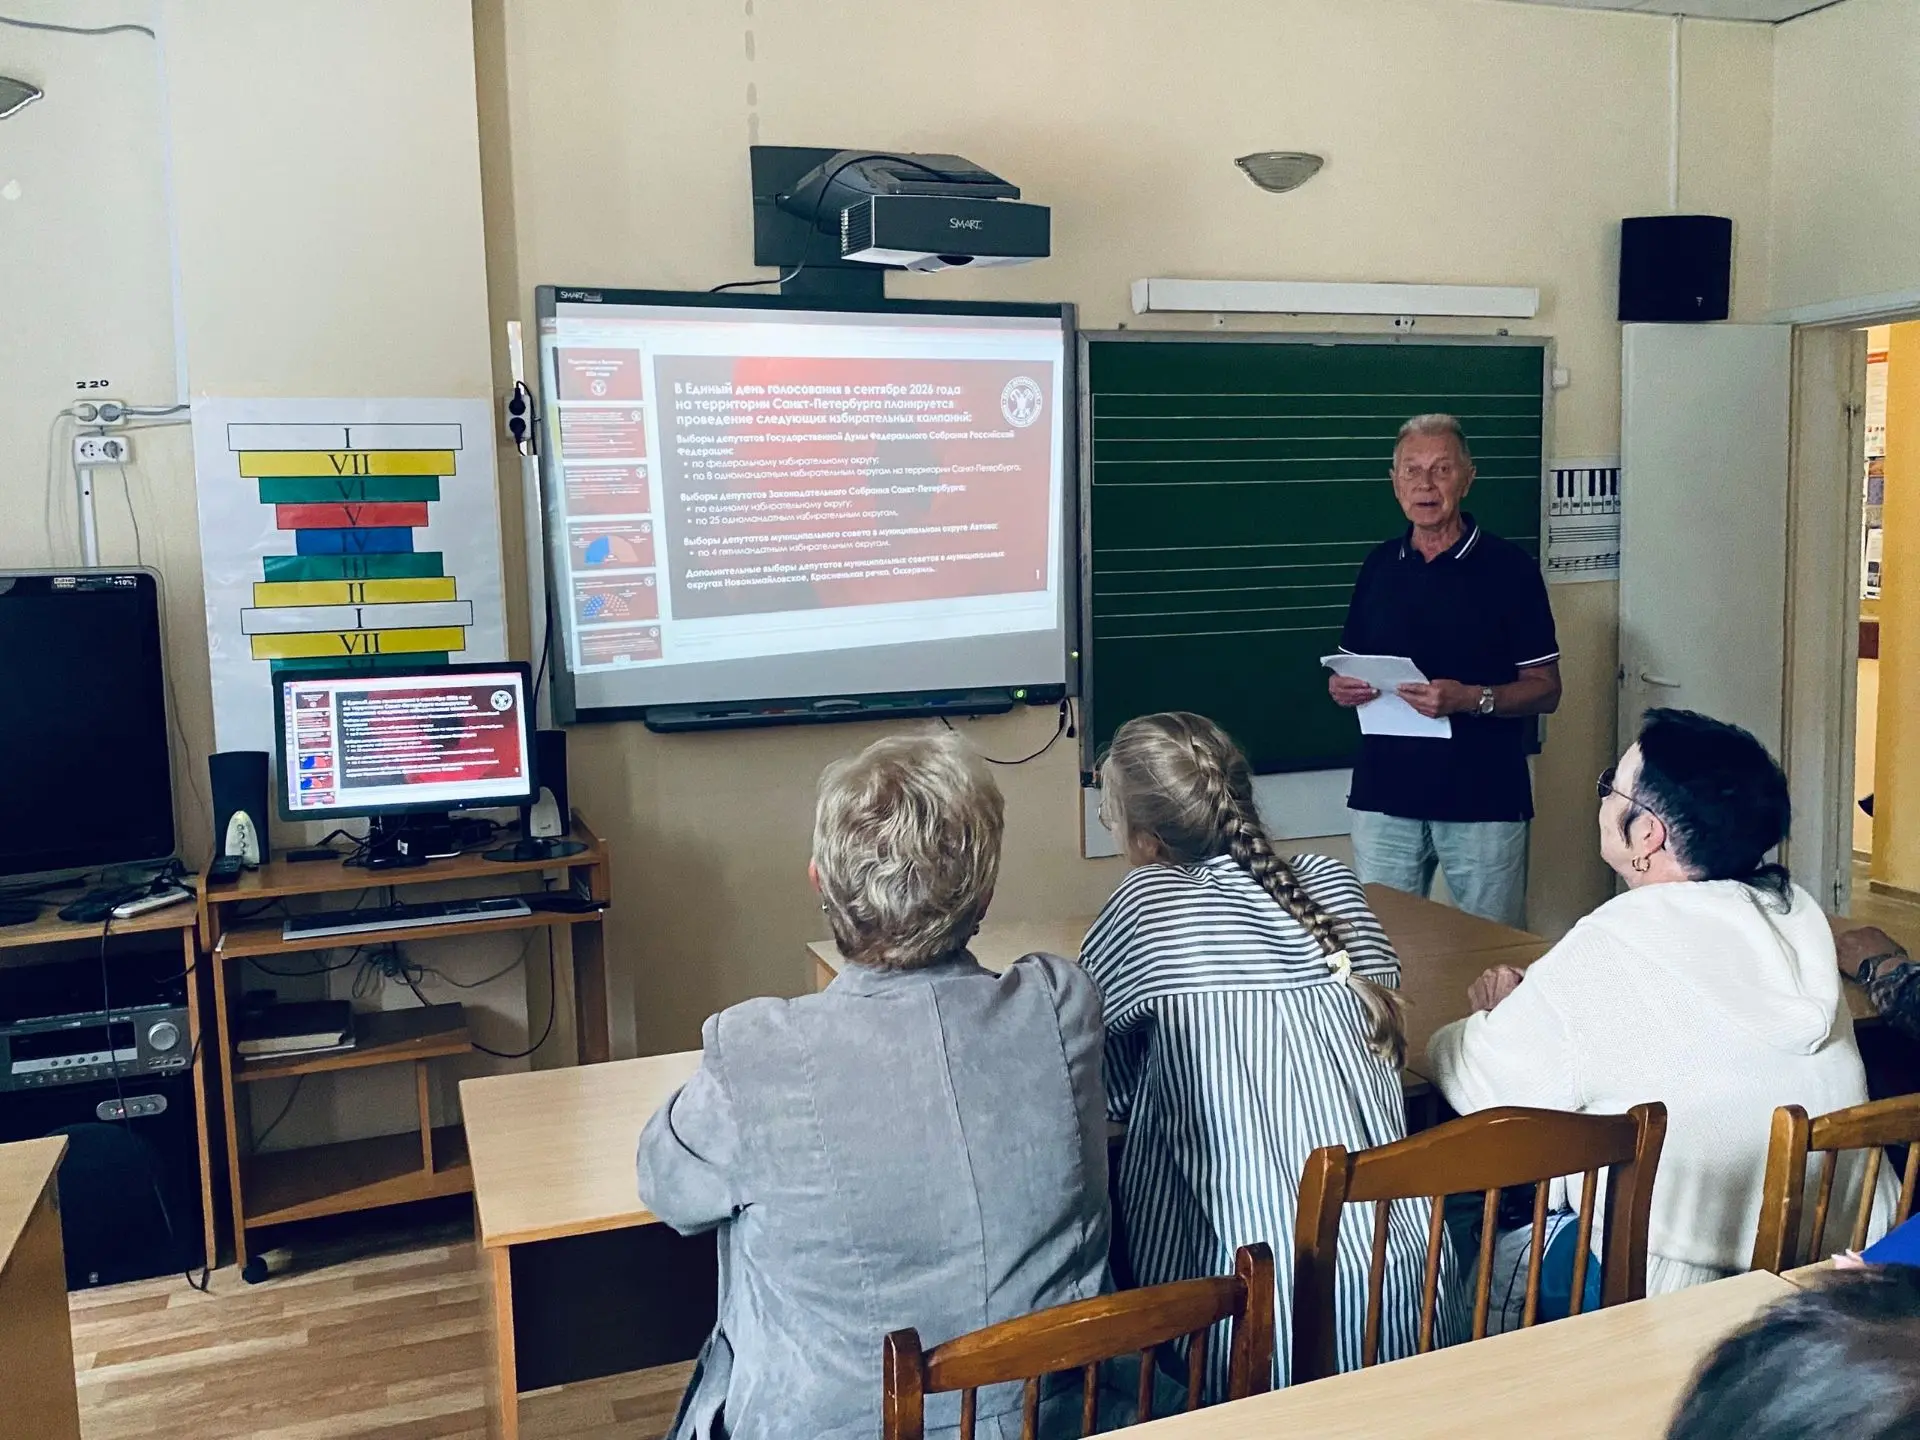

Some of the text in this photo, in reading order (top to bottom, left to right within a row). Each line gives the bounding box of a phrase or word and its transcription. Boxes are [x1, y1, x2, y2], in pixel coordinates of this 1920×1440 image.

[950, 217, 982, 230] SMART
[560, 291, 585, 299] SMART
[76, 379, 109, 389] 220
[674, 382, 961, 398] В Единый день голосования в сентябре 2026 года
[675, 397, 954, 412] на территории Санкт-Петербурга планируется
[676, 414, 753, 427] проведение
[756, 413, 827, 427] следующих
[829, 412, 914, 426] избирательных
[343, 428, 352, 448] I
[676, 434, 715, 445] Выборы
[716, 434, 765, 445] депутатов
[766, 432, 843, 444] Государственной
[844, 433, 869, 443] Думы
[869, 432, 928, 443] Федерального
[929, 431, 968, 442] Собрания
[328, 453, 371, 475] VII
[691, 461, 704, 469] по
[706, 459, 776, 469] федеральному
[692, 473, 704, 481] по
[706, 472, 713, 480] 8
[337, 480, 366, 500] VI
[680, 492, 718, 502] Выборы
[719, 492, 767, 502] депутатов
[342, 506, 362, 526] V
[694, 505, 707, 513] по
[695, 518, 708, 526] по
[709, 516, 720, 525] 25
[341, 531, 370, 553] IV
[341, 556, 368, 578] III
[347, 582, 366, 603] II
[355, 608, 364, 628] I
[338, 632, 381, 654] VII
